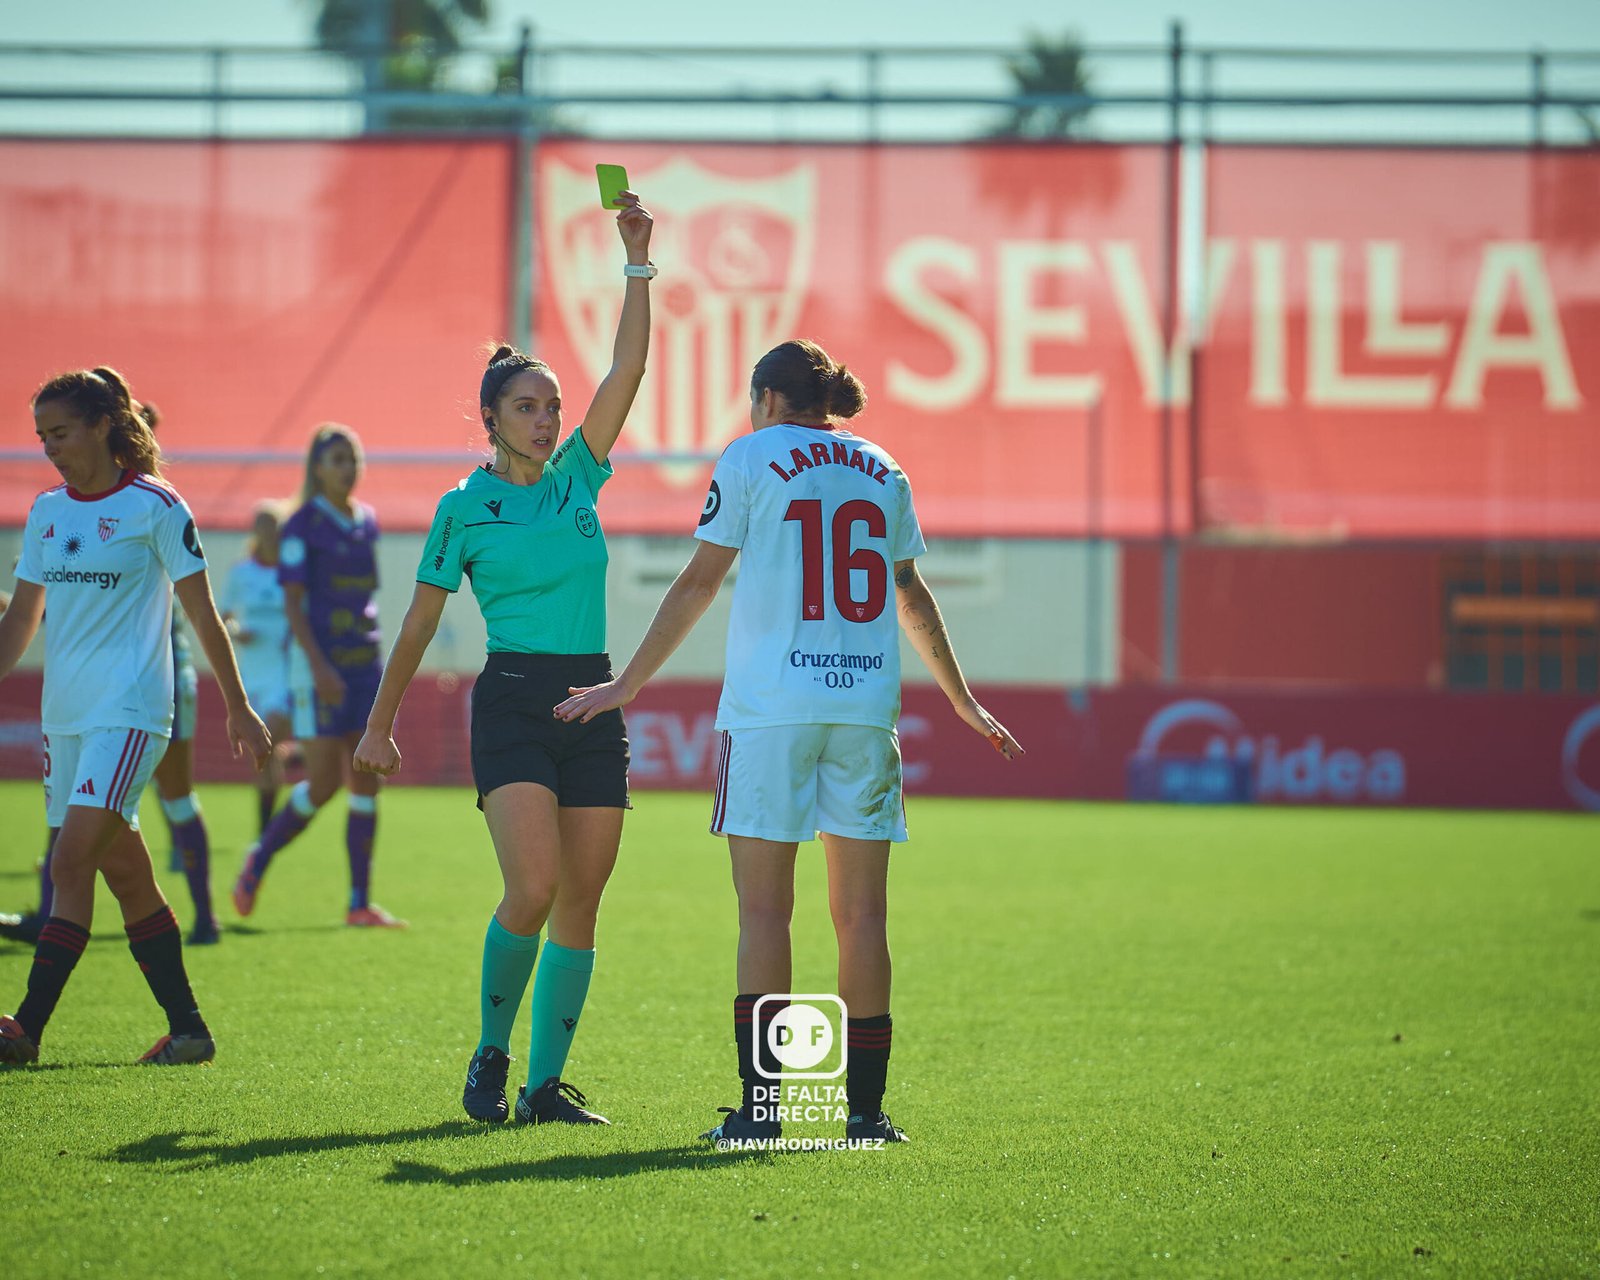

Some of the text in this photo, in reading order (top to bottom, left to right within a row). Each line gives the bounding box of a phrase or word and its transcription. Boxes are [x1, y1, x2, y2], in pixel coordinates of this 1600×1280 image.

[883, 236, 1583, 412] SEVILLA
[768, 441, 890, 486] I.ARNAIZ
[783, 498, 887, 623] 16
[825, 671, 854, 689] 0.0
